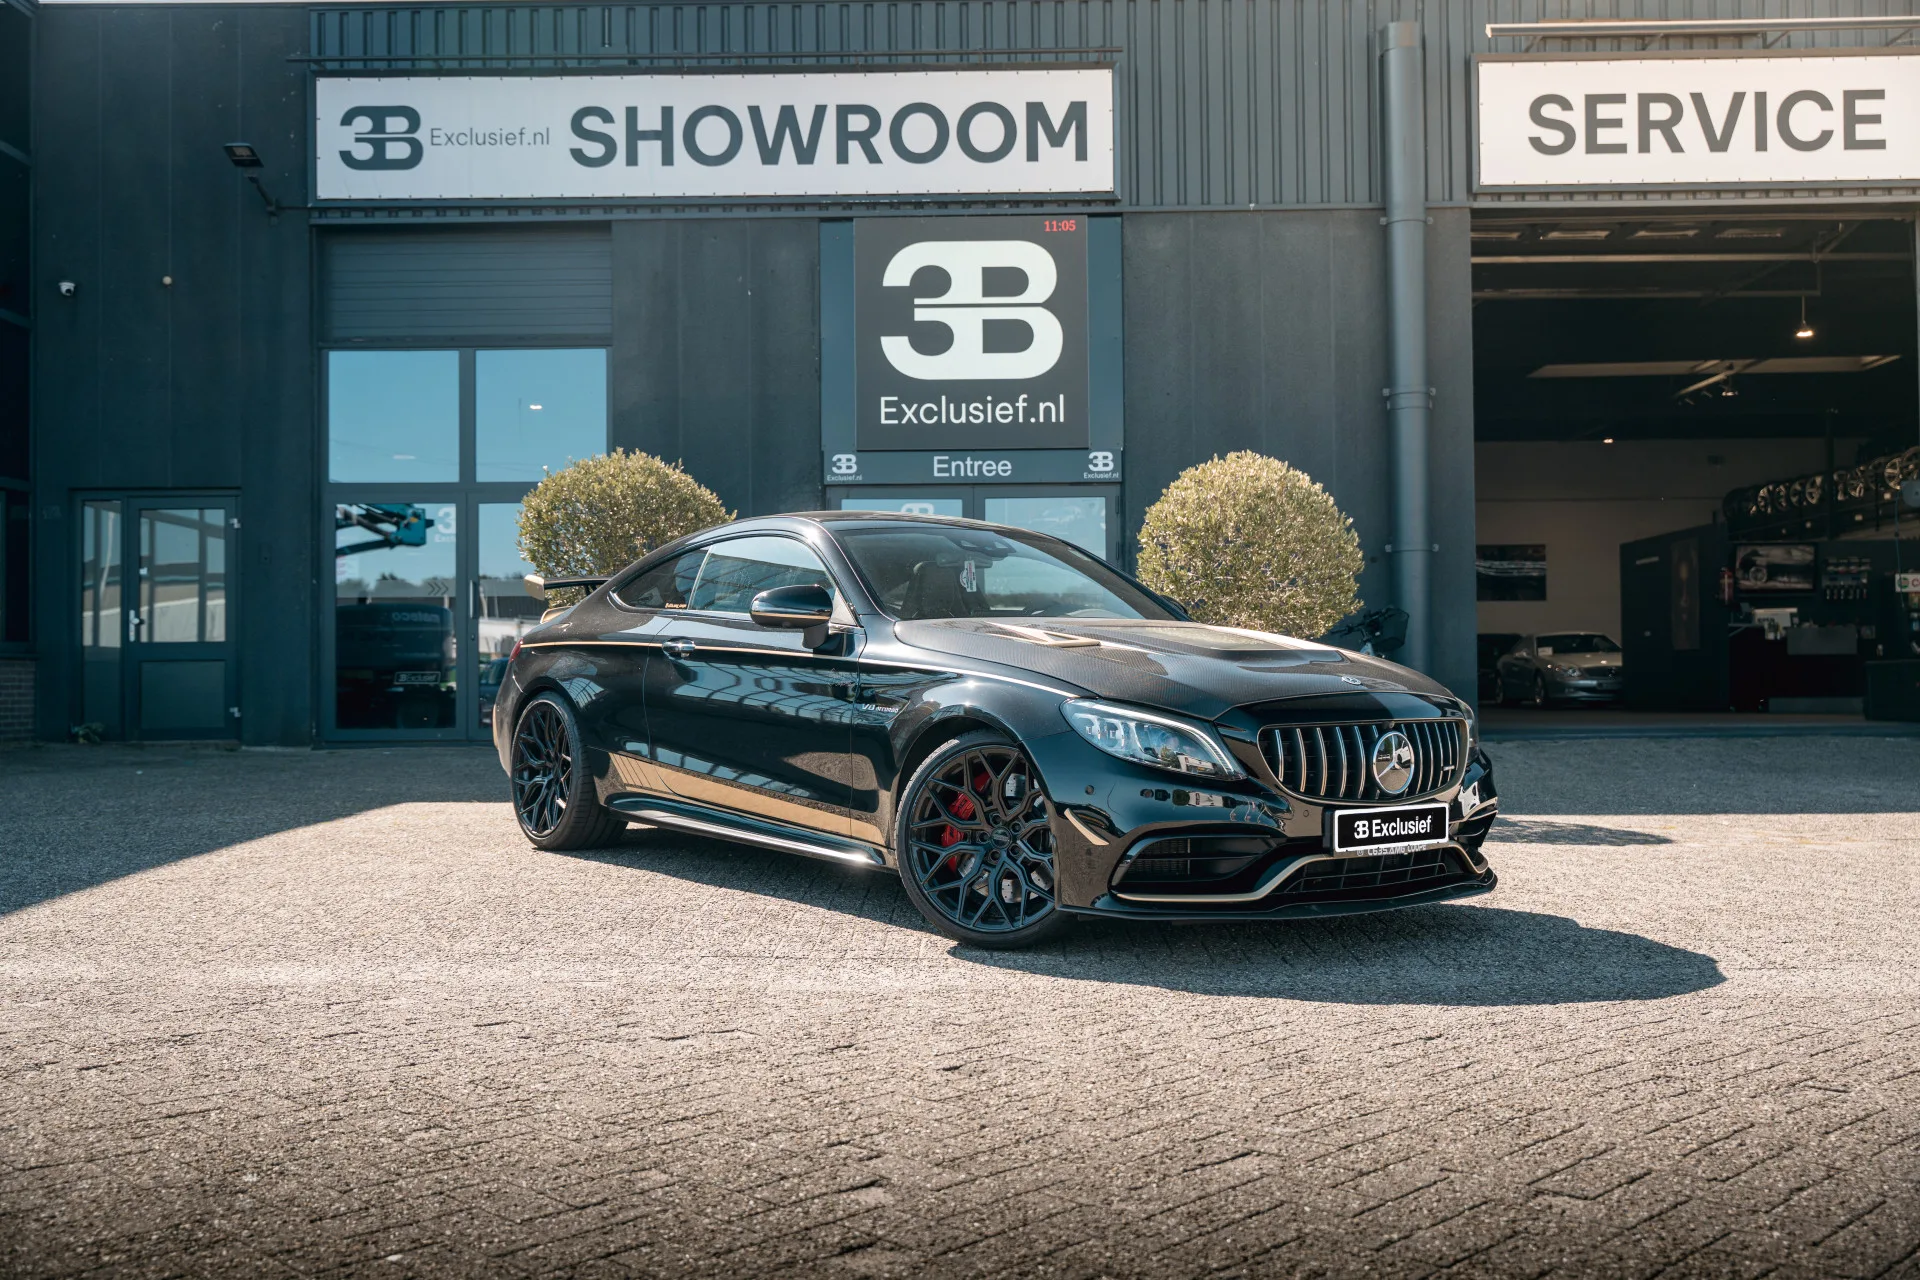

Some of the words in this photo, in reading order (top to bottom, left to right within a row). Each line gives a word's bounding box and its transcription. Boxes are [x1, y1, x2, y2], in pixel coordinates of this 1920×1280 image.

[1528, 89, 1887, 156] SERVICE
[339, 105, 424, 171] 3B
[430, 127, 550, 147] Exclusief.nl
[569, 101, 1088, 169] SHOWROOM
[1044, 219, 1076, 232] 11:05
[880, 240, 1064, 380] 3B
[880, 394, 1065, 424] Exclusief.nl
[832, 453, 857, 473] 3B
[933, 455, 1012, 477] Entree
[1088, 451, 1114, 471] 3B
[1083, 471, 1119, 479] Exclusief.nl
[1353, 820, 1370, 839] 3B
[1372, 815, 1432, 838] Exclusief
